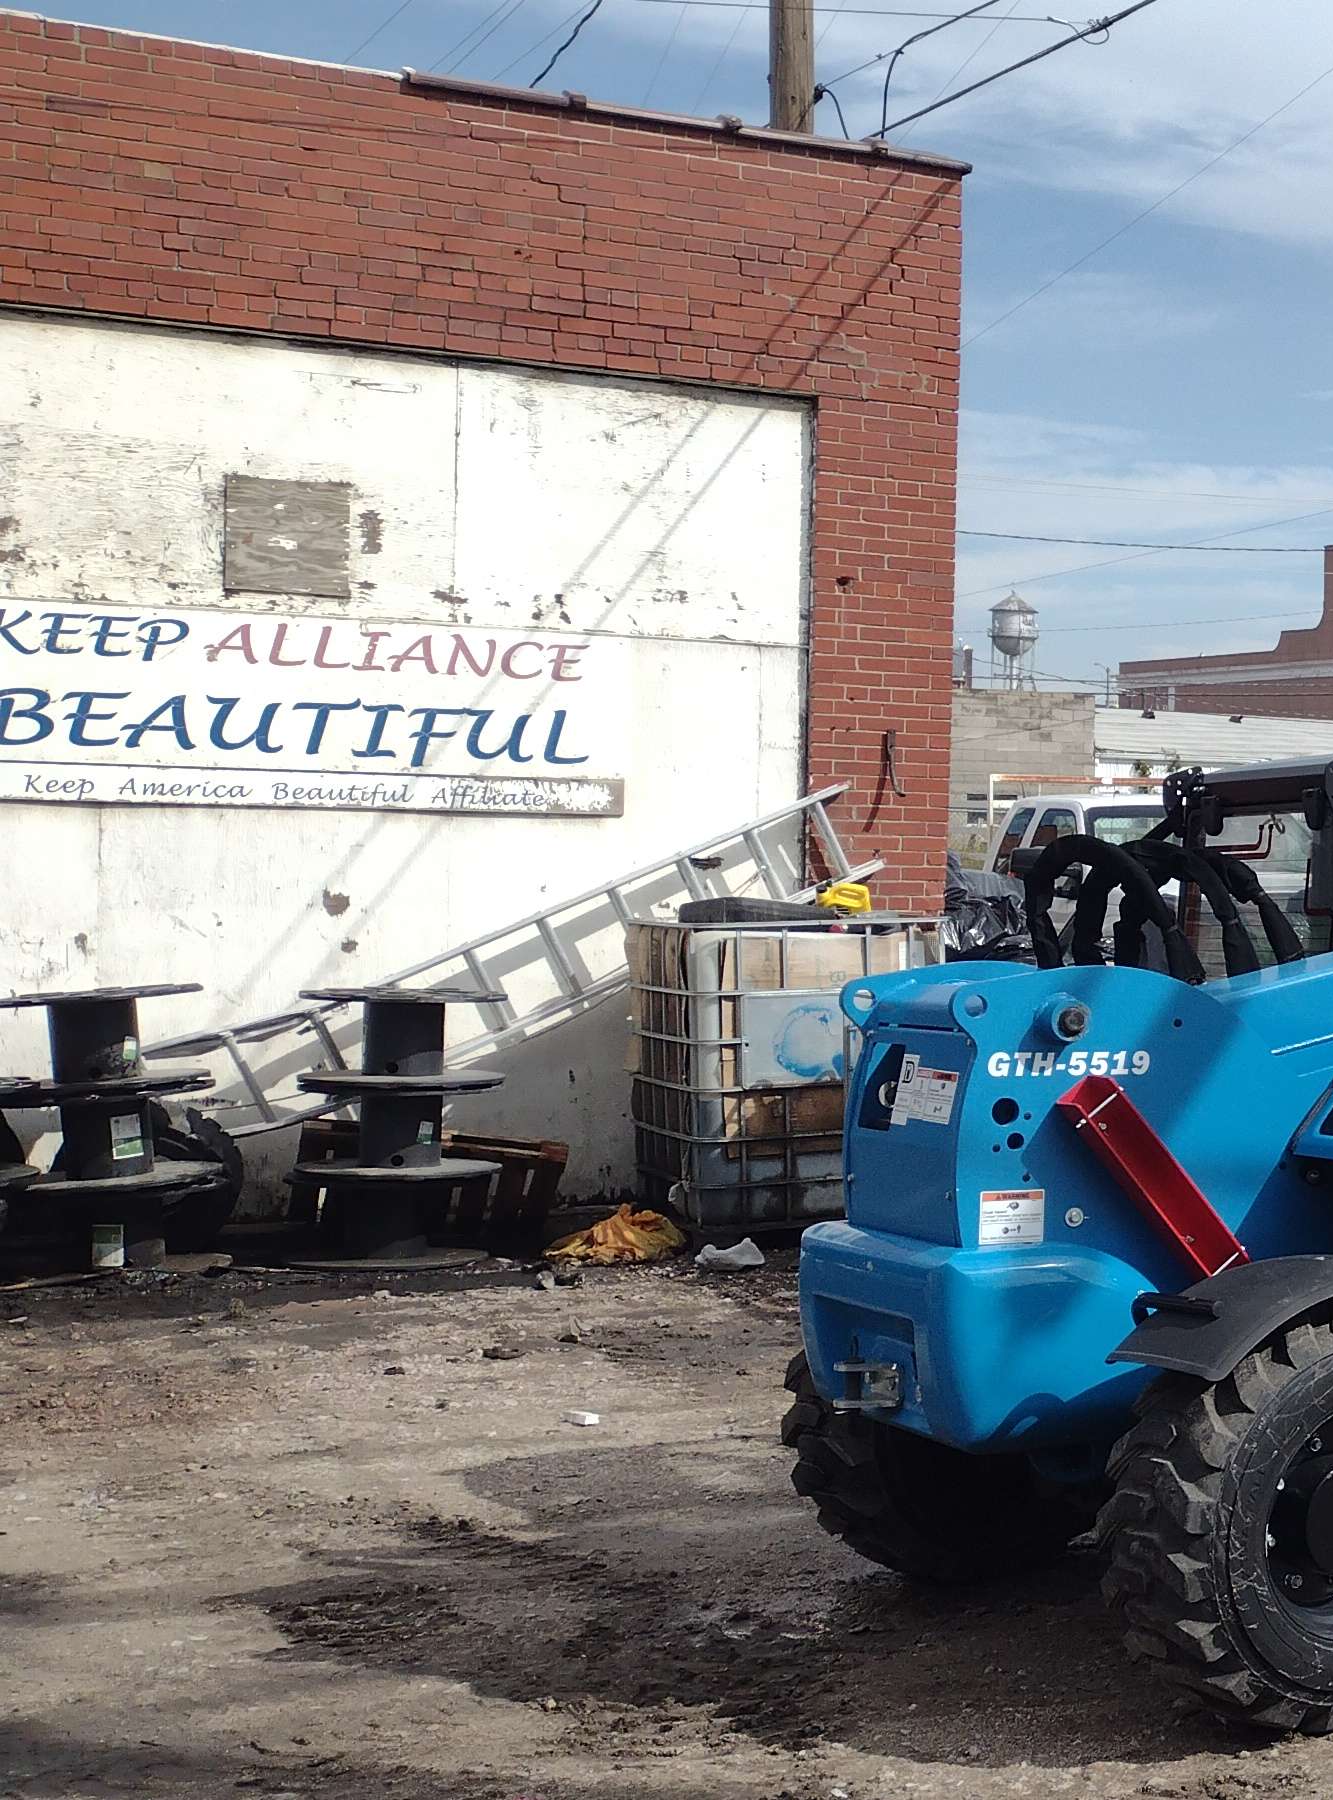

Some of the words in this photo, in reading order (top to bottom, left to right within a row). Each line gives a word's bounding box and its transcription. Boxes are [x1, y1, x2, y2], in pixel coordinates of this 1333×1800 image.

[0, 608, 190, 662] KEEP
[203, 622, 590, 682] ALLIANCE
[0, 687, 590, 768] BEAUTIFUL
[23, 774, 95, 800] Keep
[118, 777, 254, 799] America
[271, 781, 415, 805] Beautiful
[431, 784, 549, 807] Affiliate
[987, 1050, 1151, 1077] GTH-5519
